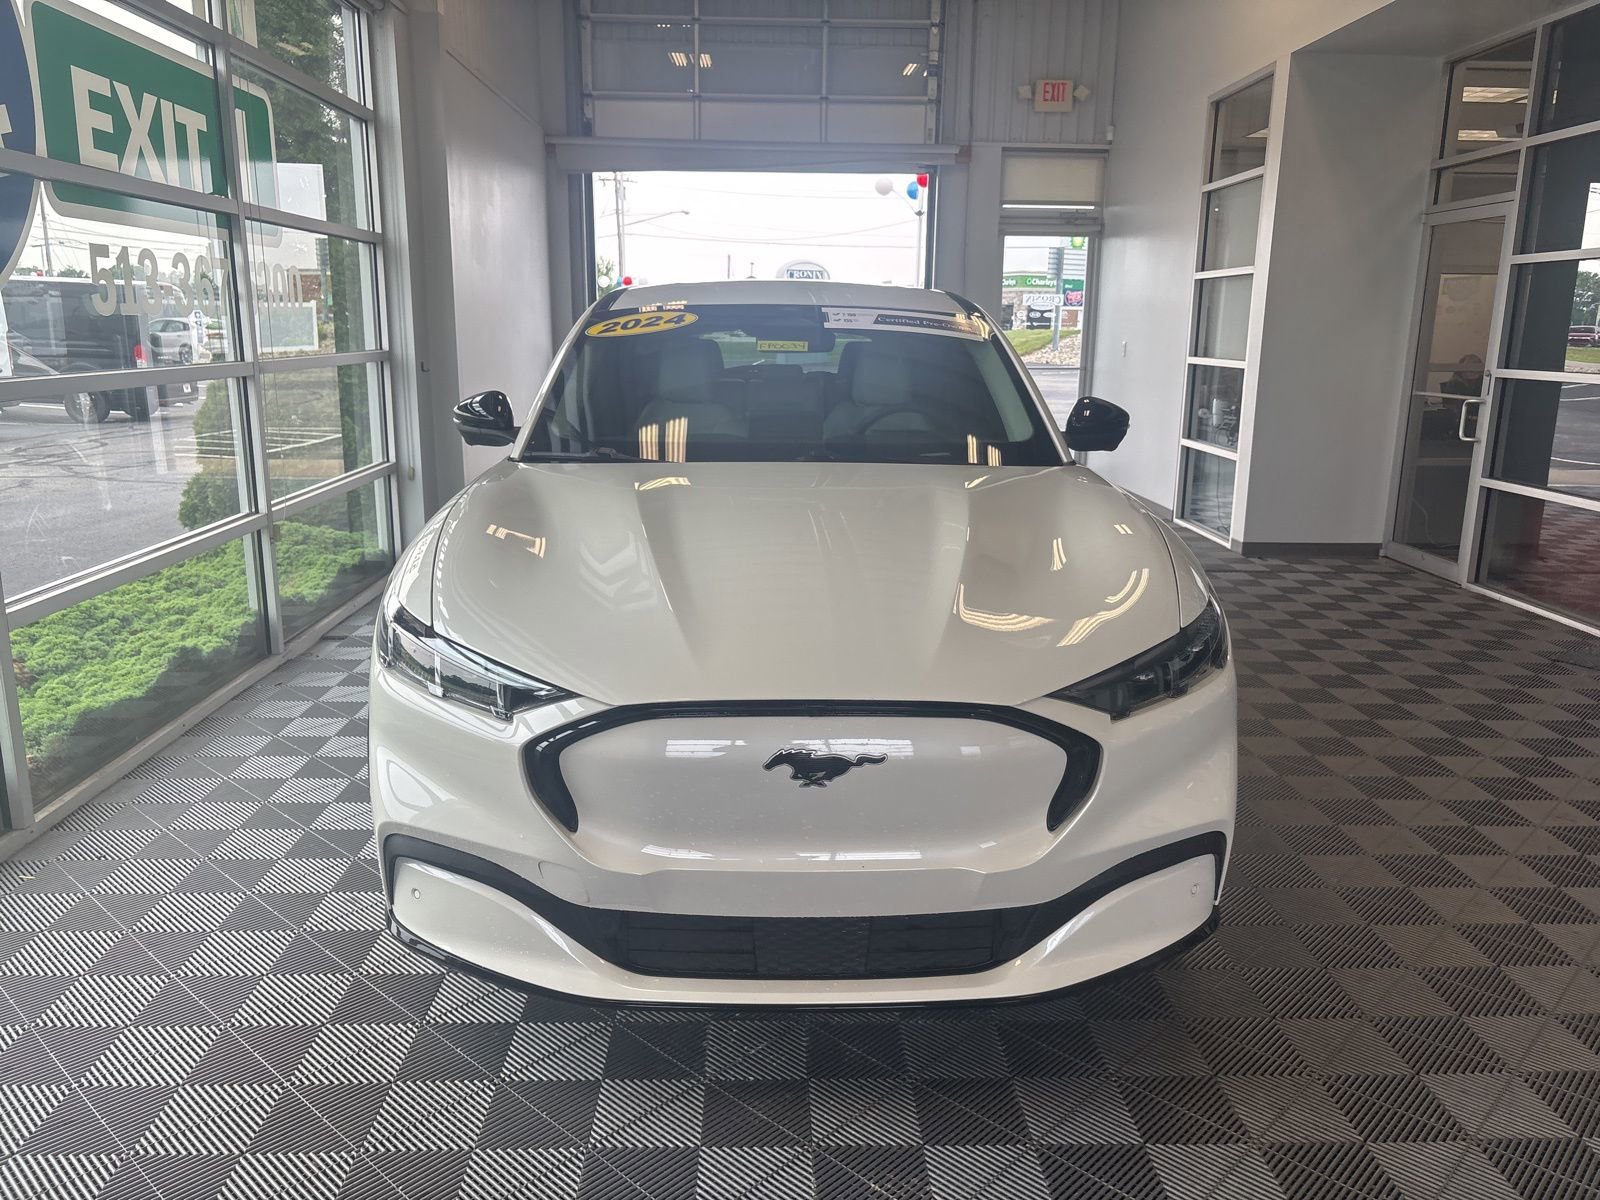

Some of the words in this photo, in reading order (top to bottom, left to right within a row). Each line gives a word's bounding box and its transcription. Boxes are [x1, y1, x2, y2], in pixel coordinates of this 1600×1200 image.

[1042, 81, 1068, 102] EXIT
[70, 65, 213, 194] EXIT
[597, 313, 687, 335] 2024
[877, 316, 920, 326] Certified
